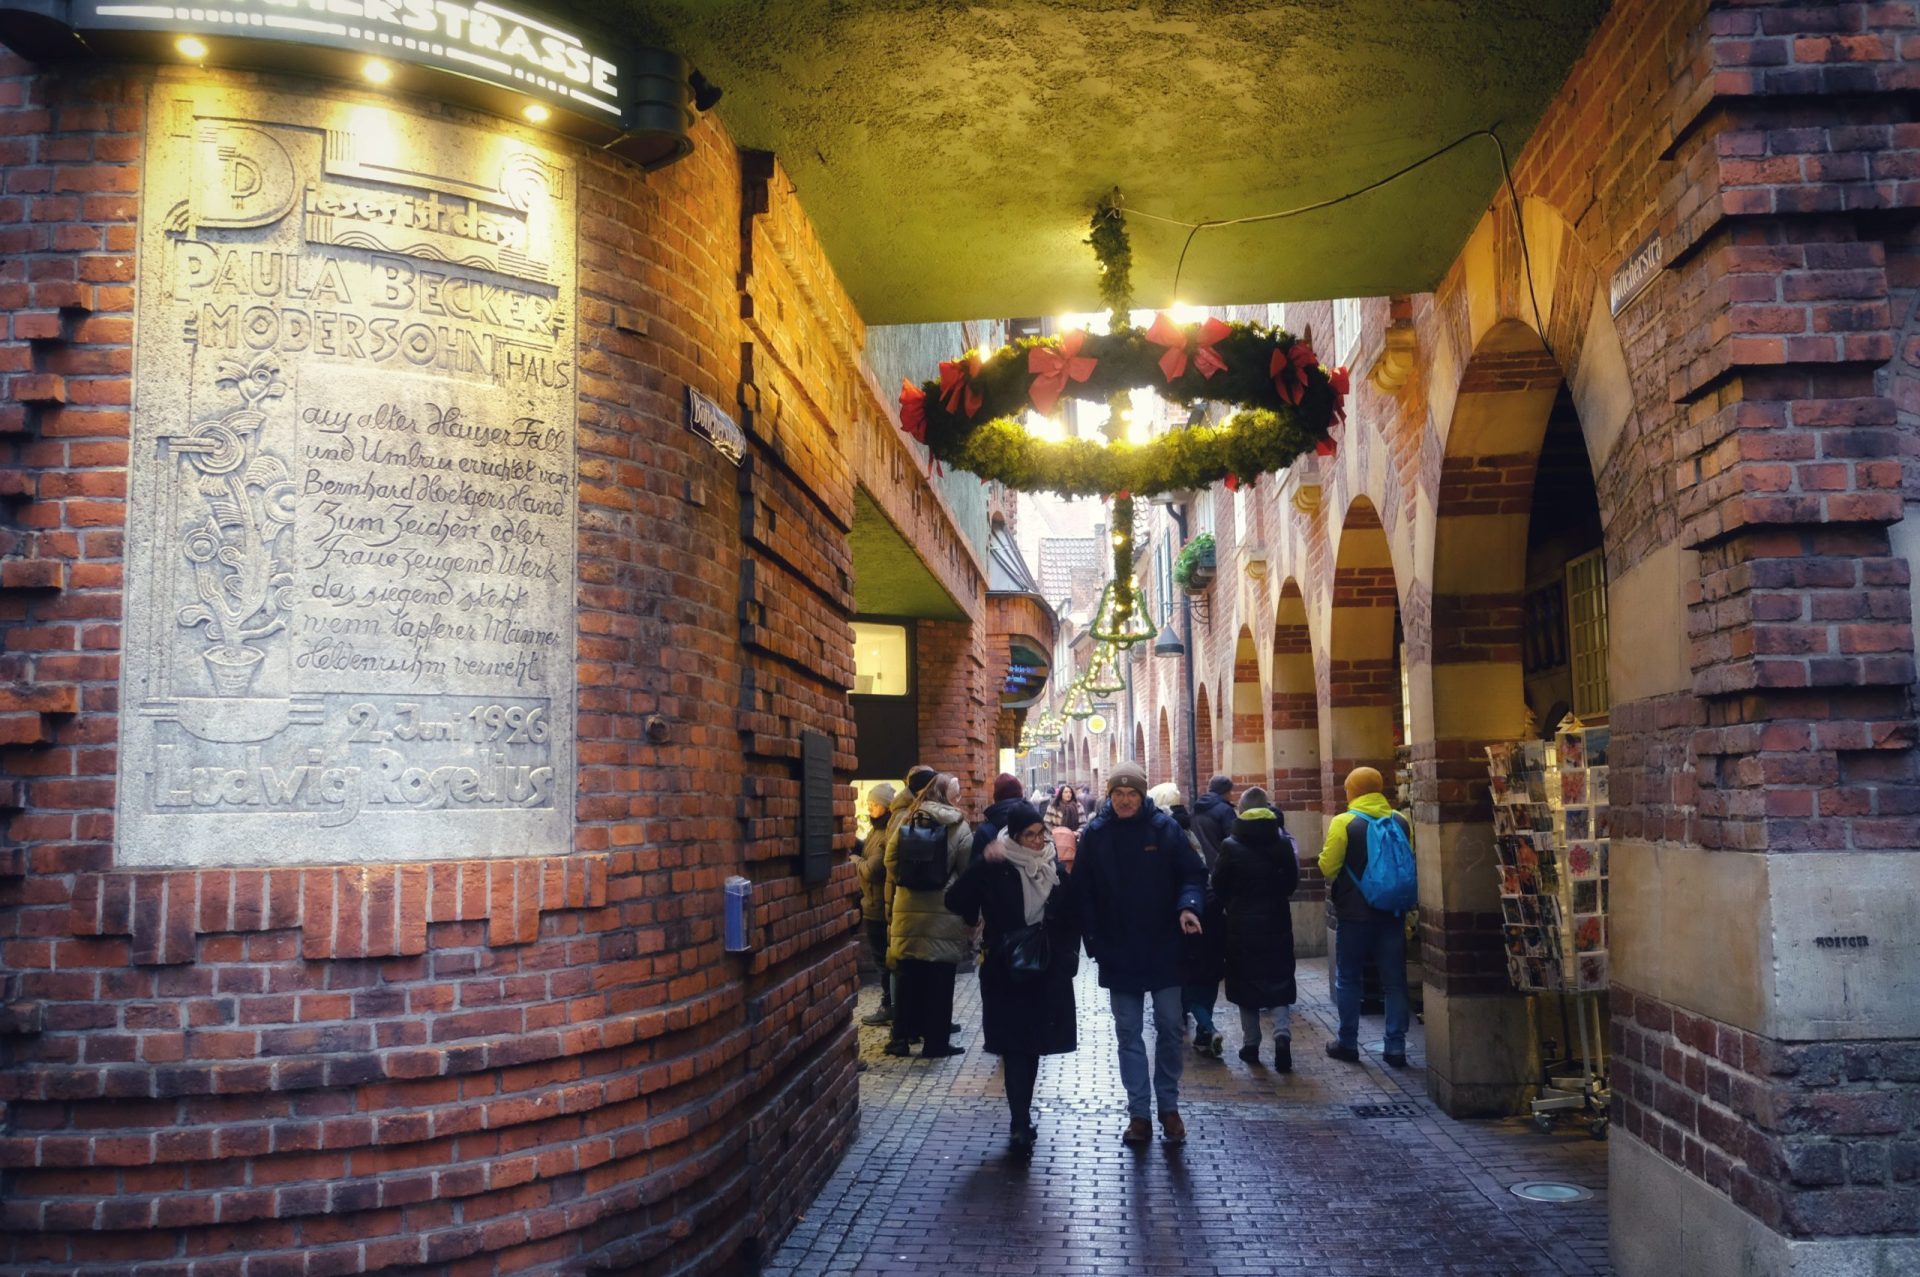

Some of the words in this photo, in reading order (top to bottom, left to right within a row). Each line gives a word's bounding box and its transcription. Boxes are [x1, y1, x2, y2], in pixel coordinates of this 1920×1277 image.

[173, 238, 352, 305] PAULA
[202, 302, 495, 377] MODERSOHN
[506, 351, 571, 390] HAUS
[305, 435, 355, 462] und
[357, 402, 420, 434] alter
[512, 416, 566, 454] Fall
[301, 468, 416, 502] Bernhard
[506, 483, 566, 517] Hand
[490, 514, 550, 548] edler
[499, 543, 561, 584] Werk
[311, 573, 356, 608] das
[303, 613, 380, 636] wenn
[154, 743, 361, 829] Ludwig
[367, 747, 555, 810] Roselius
